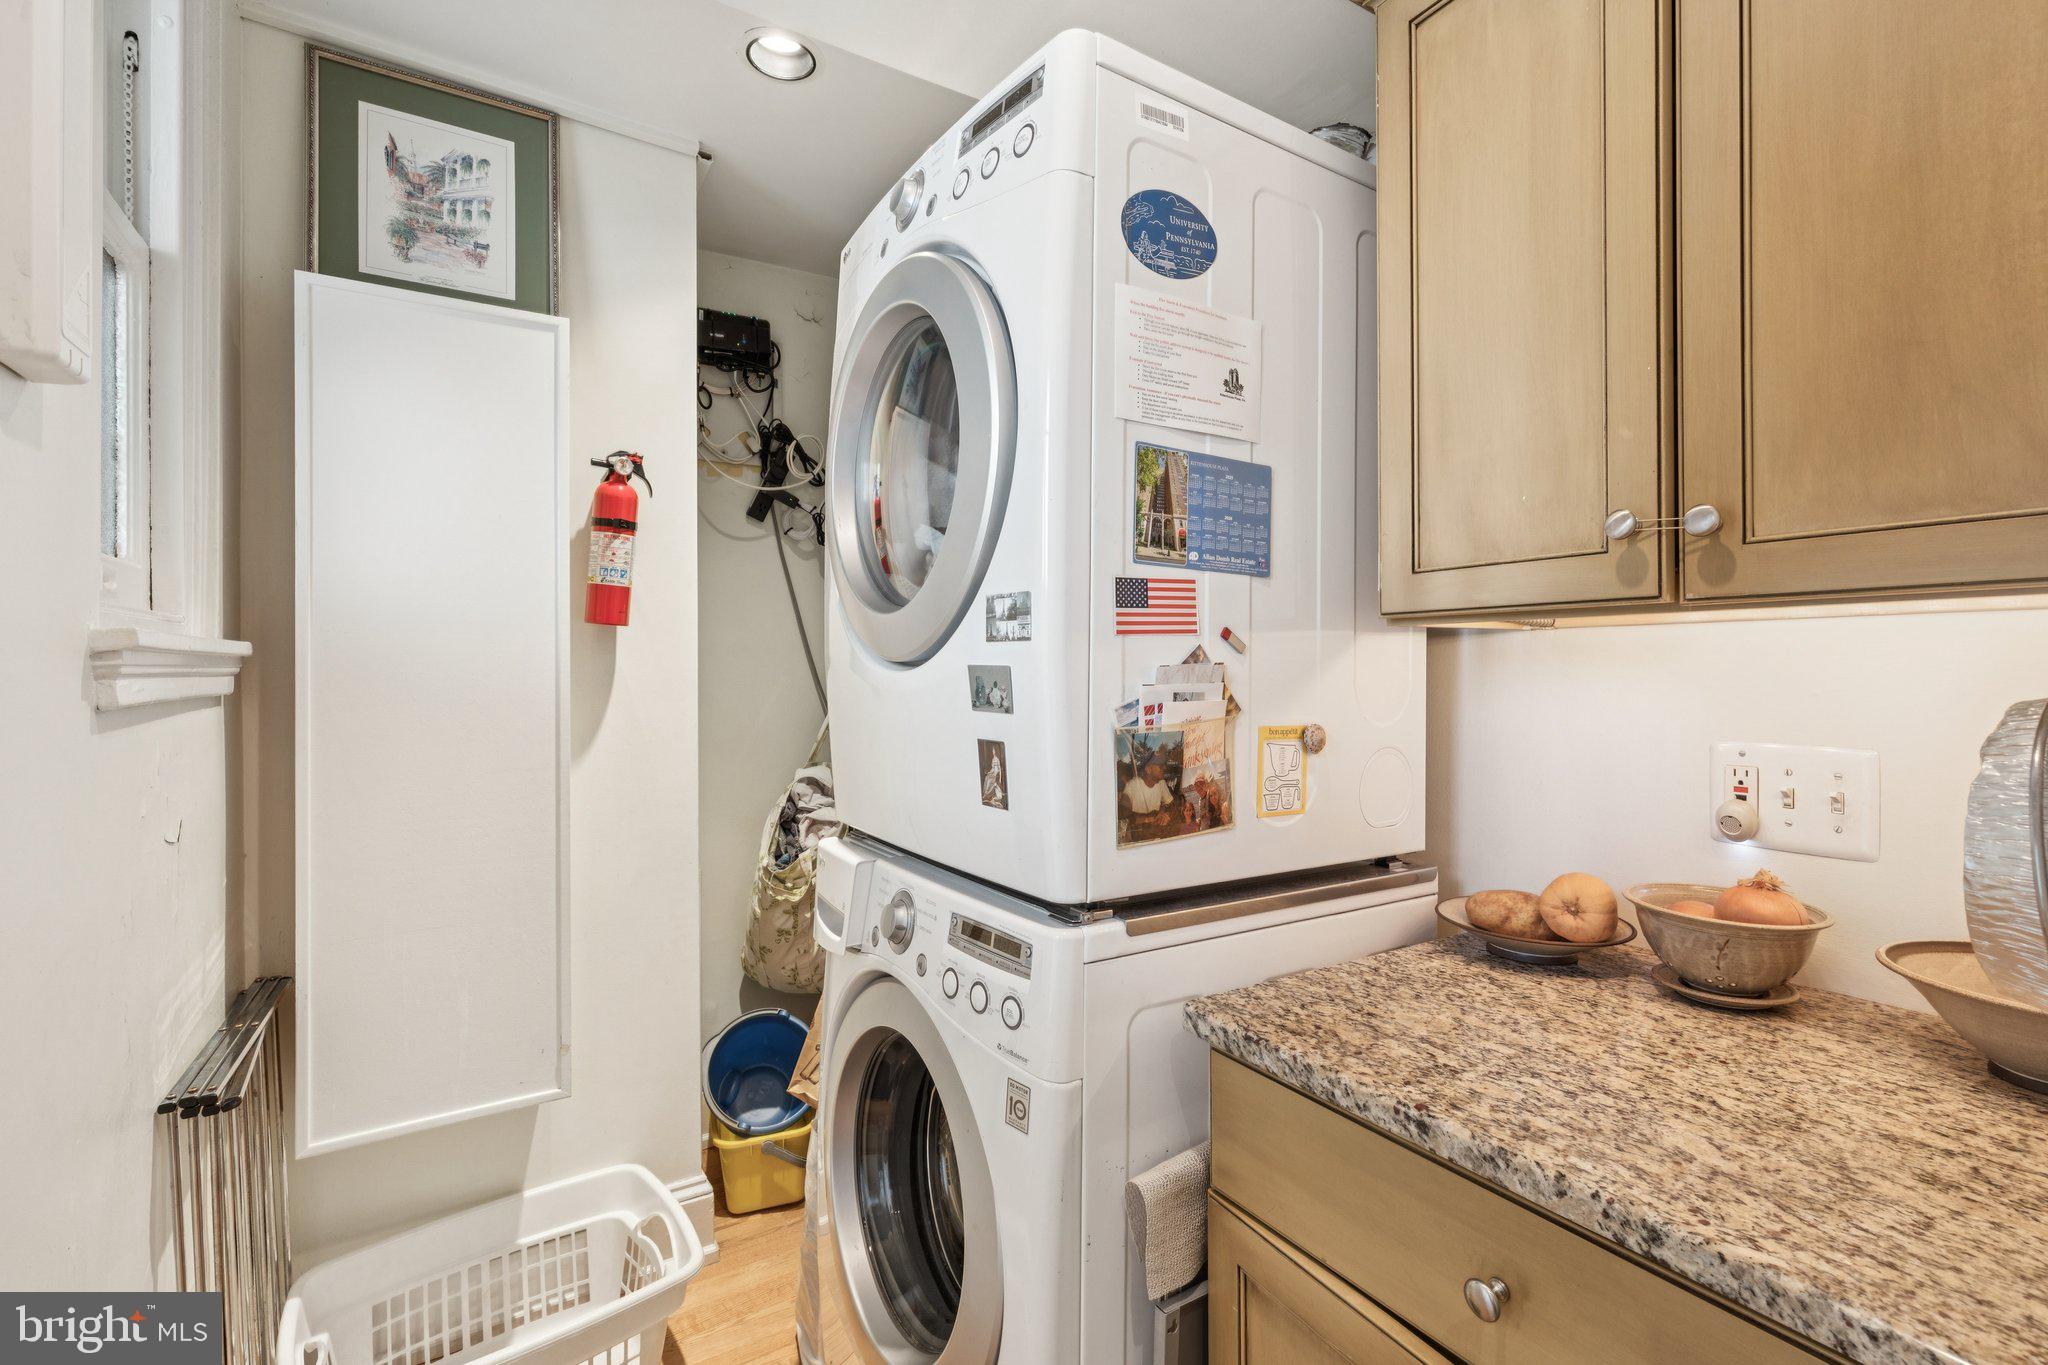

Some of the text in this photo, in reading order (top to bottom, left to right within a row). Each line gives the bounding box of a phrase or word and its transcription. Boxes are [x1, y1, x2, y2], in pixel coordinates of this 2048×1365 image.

[1169, 215, 1209, 232] UNIVERSITY
[1165, 231, 1215, 250] PENNSYLVANIA
[1009, 1095, 1027, 1121] 10
